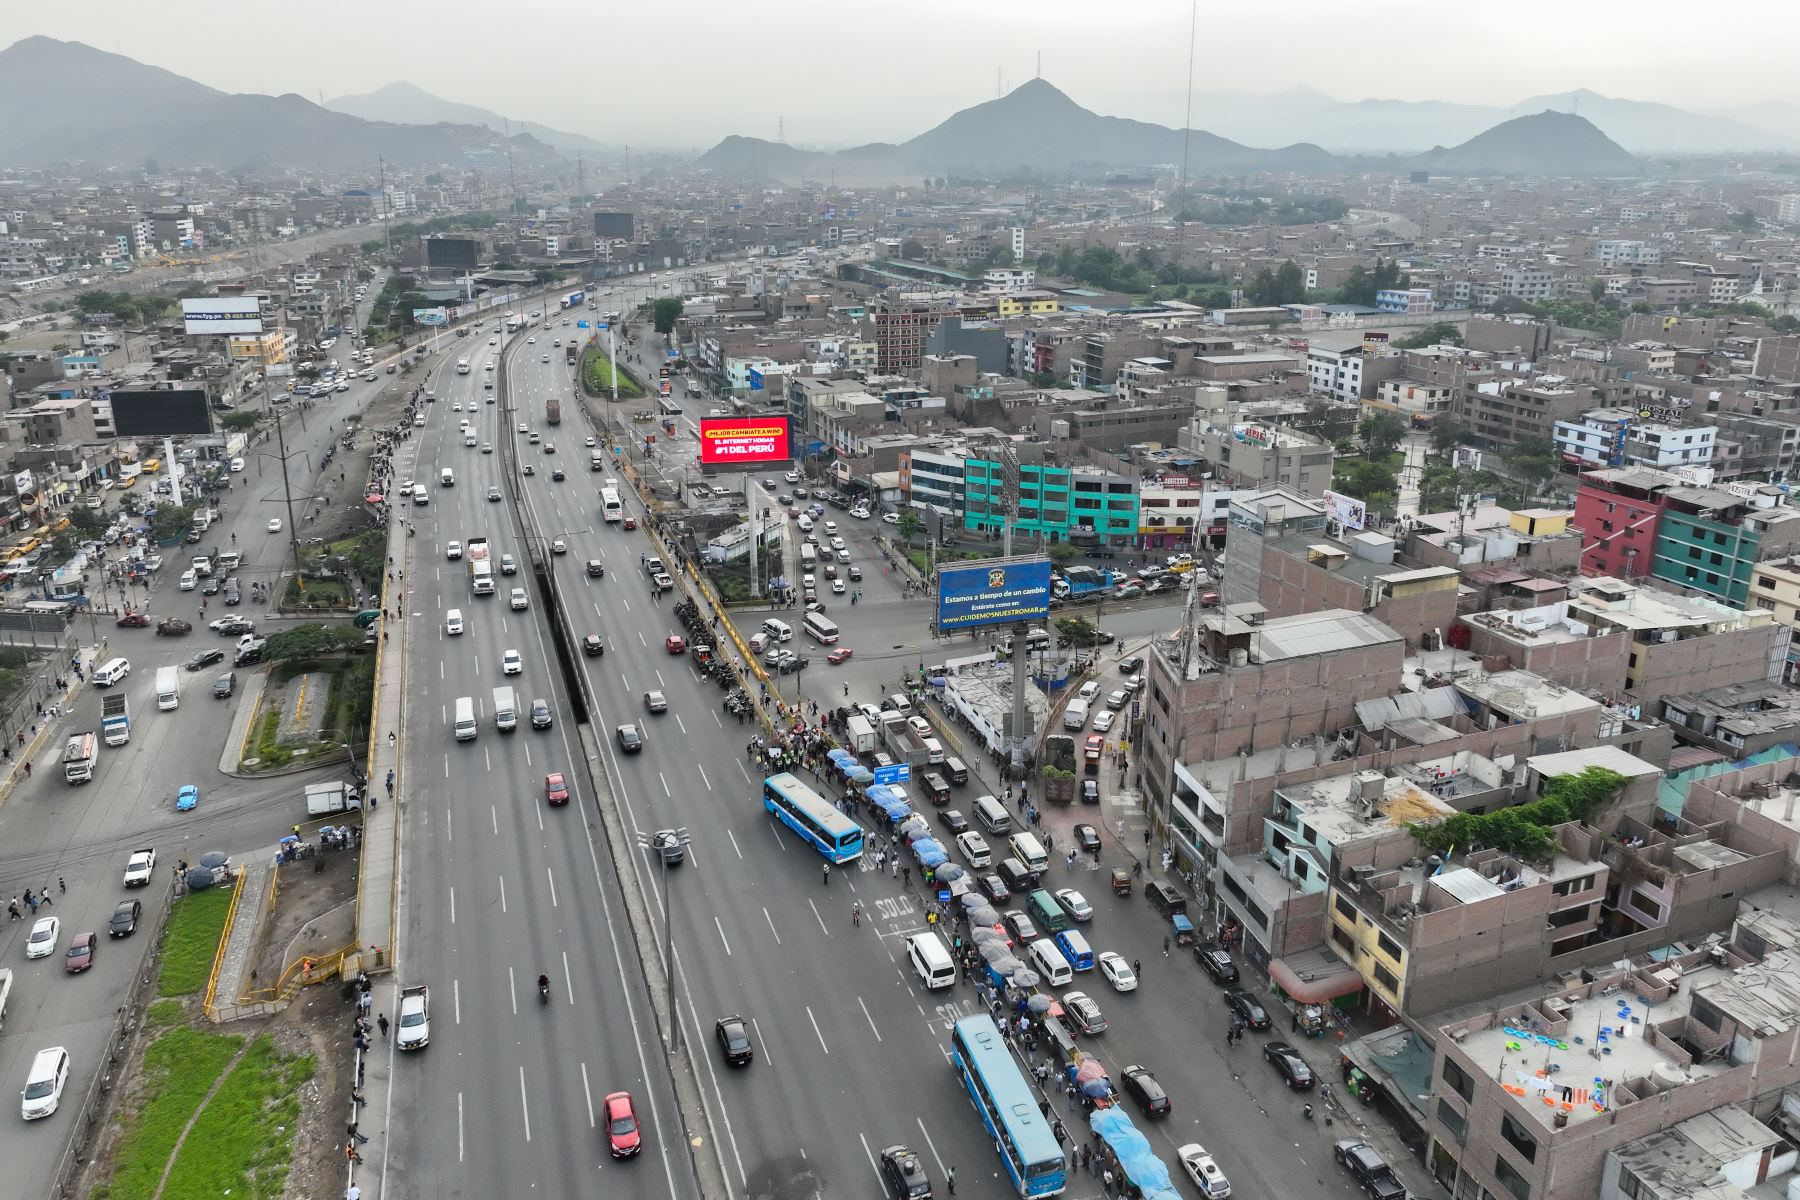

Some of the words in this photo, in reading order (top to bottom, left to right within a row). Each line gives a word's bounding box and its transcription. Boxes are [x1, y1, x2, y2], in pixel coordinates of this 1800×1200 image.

[1640, 404, 1682, 418] HOSTAL
[749, 443, 774, 453] PERÚ
[945, 595, 974, 603] Estamos
[1023, 586, 1046, 594] cambio
[874, 896, 914, 920] SOLO
